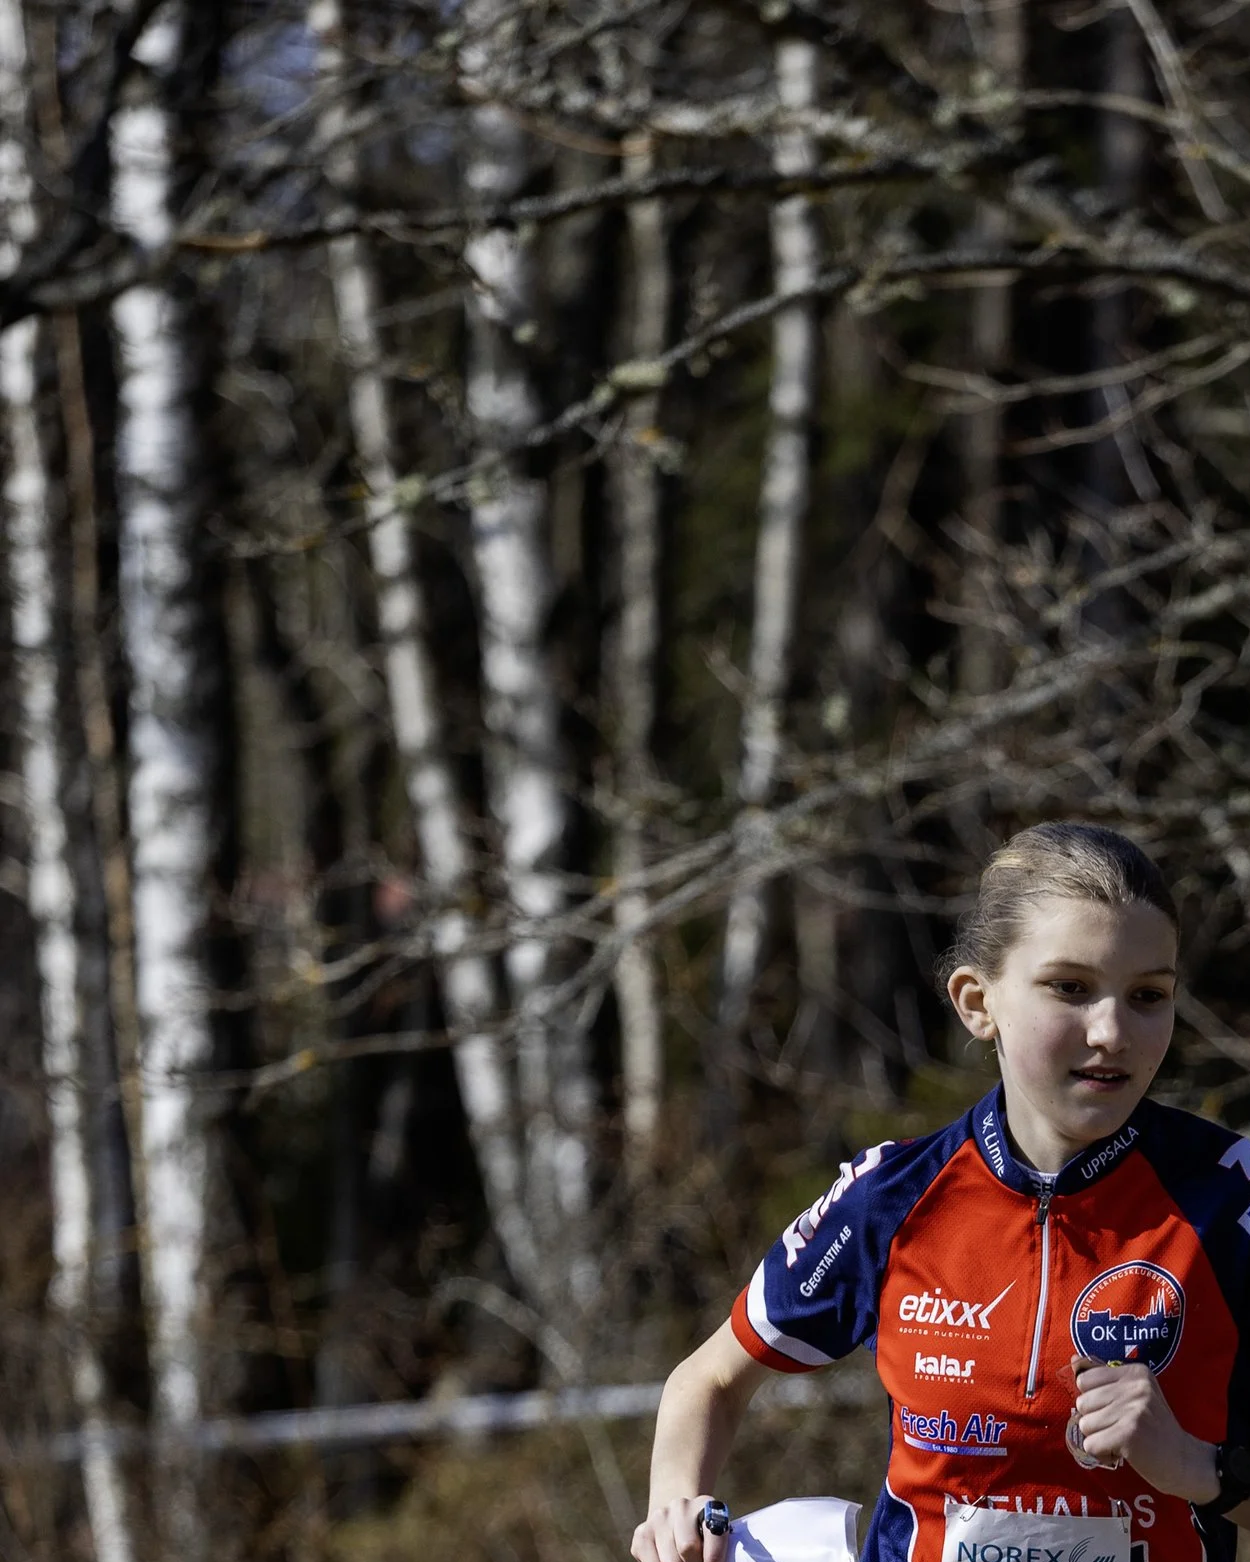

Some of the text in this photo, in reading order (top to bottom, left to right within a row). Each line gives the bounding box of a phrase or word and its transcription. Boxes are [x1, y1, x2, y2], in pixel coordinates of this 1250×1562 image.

[1080, 1126, 1140, 1179] UPPSALA
[840, 1224, 853, 1244] AB
[1079, 1268, 1167, 1319] ORIENTERINGSKLUBBEN
[898, 1287, 984, 1329] etixx
[898, 1327, 991, 1341] sports nutrition
[1091, 1322, 1170, 1342] OK Linné
[914, 1351, 976, 1378] kalas
[914, 1374, 975, 1385] SPORTSWEAR
[900, 1406, 1008, 1444] Fresh Air
